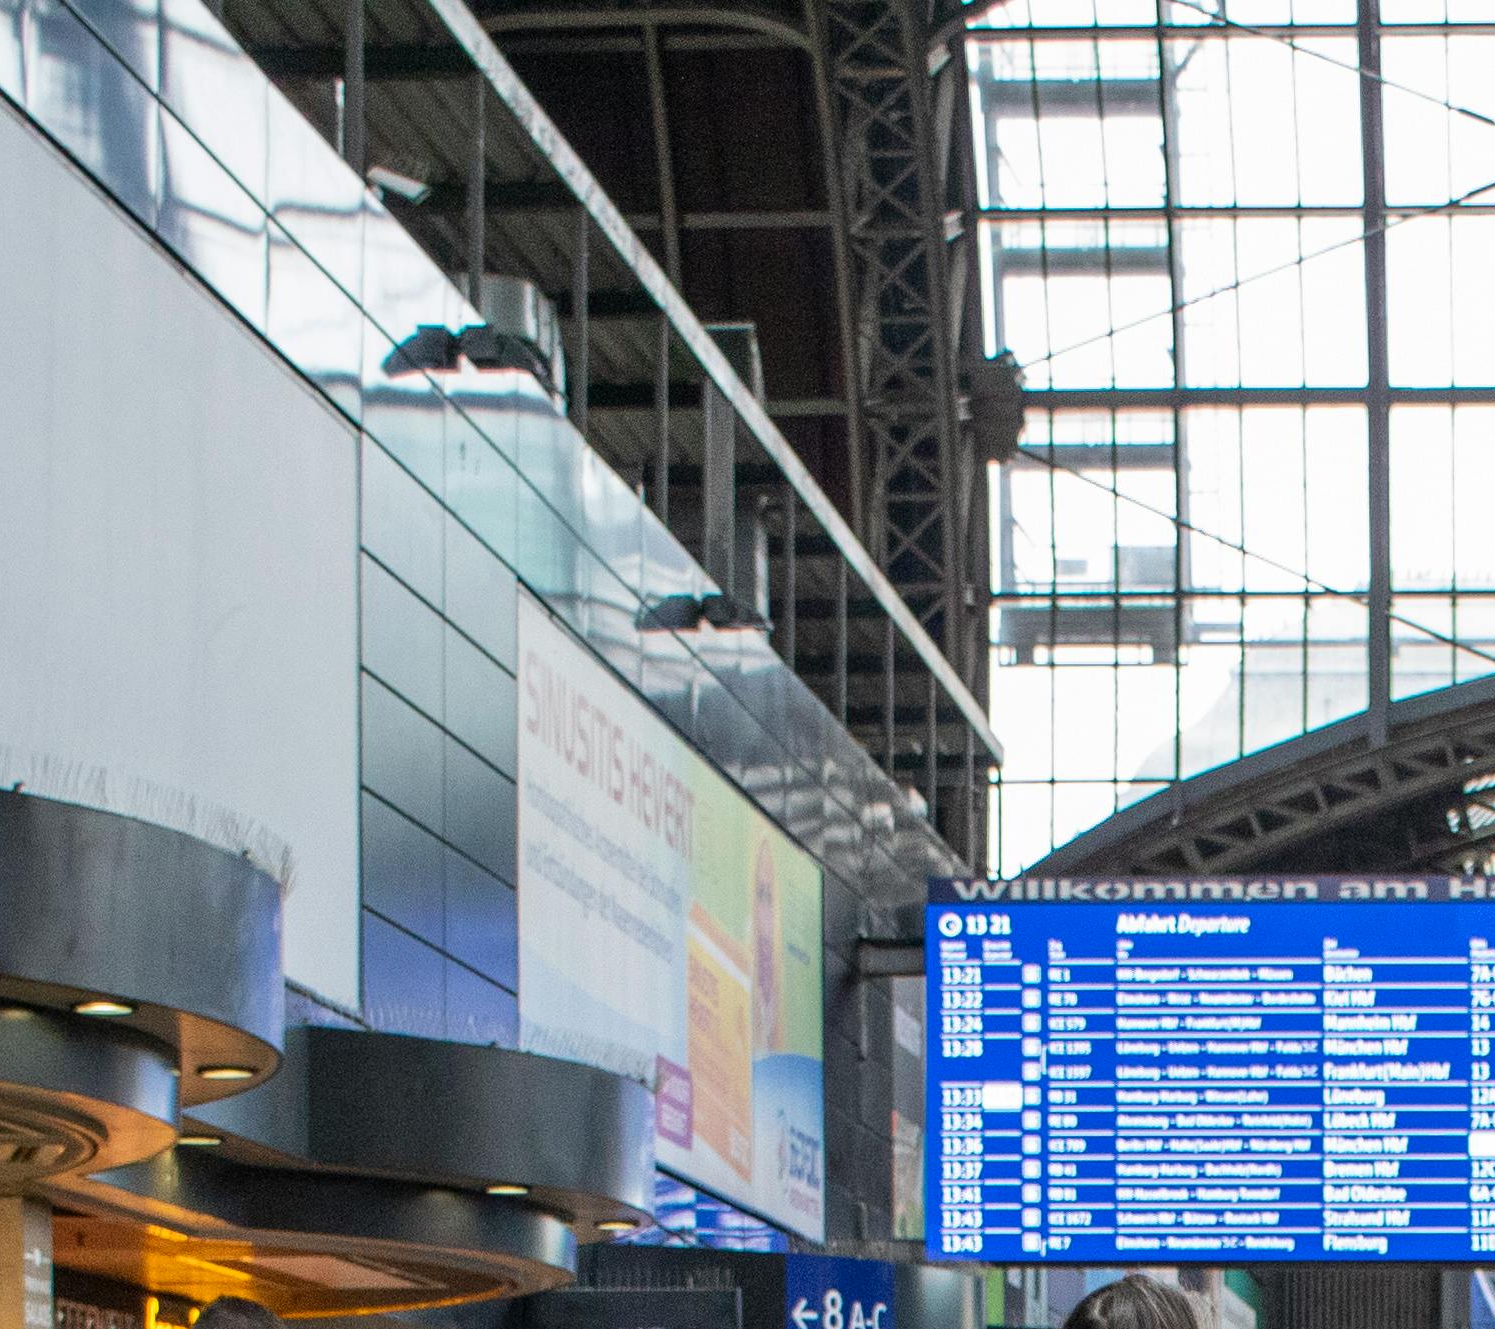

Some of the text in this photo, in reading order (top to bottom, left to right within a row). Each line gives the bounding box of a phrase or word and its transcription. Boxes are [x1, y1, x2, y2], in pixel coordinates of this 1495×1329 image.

[954, 878, 1319, 900] Willkommen
[1338, 878, 1428, 899] am
[1116, 913, 1251, 937] Abfahrt Departure
[1323, 1185, 1350, 1203] Bad
